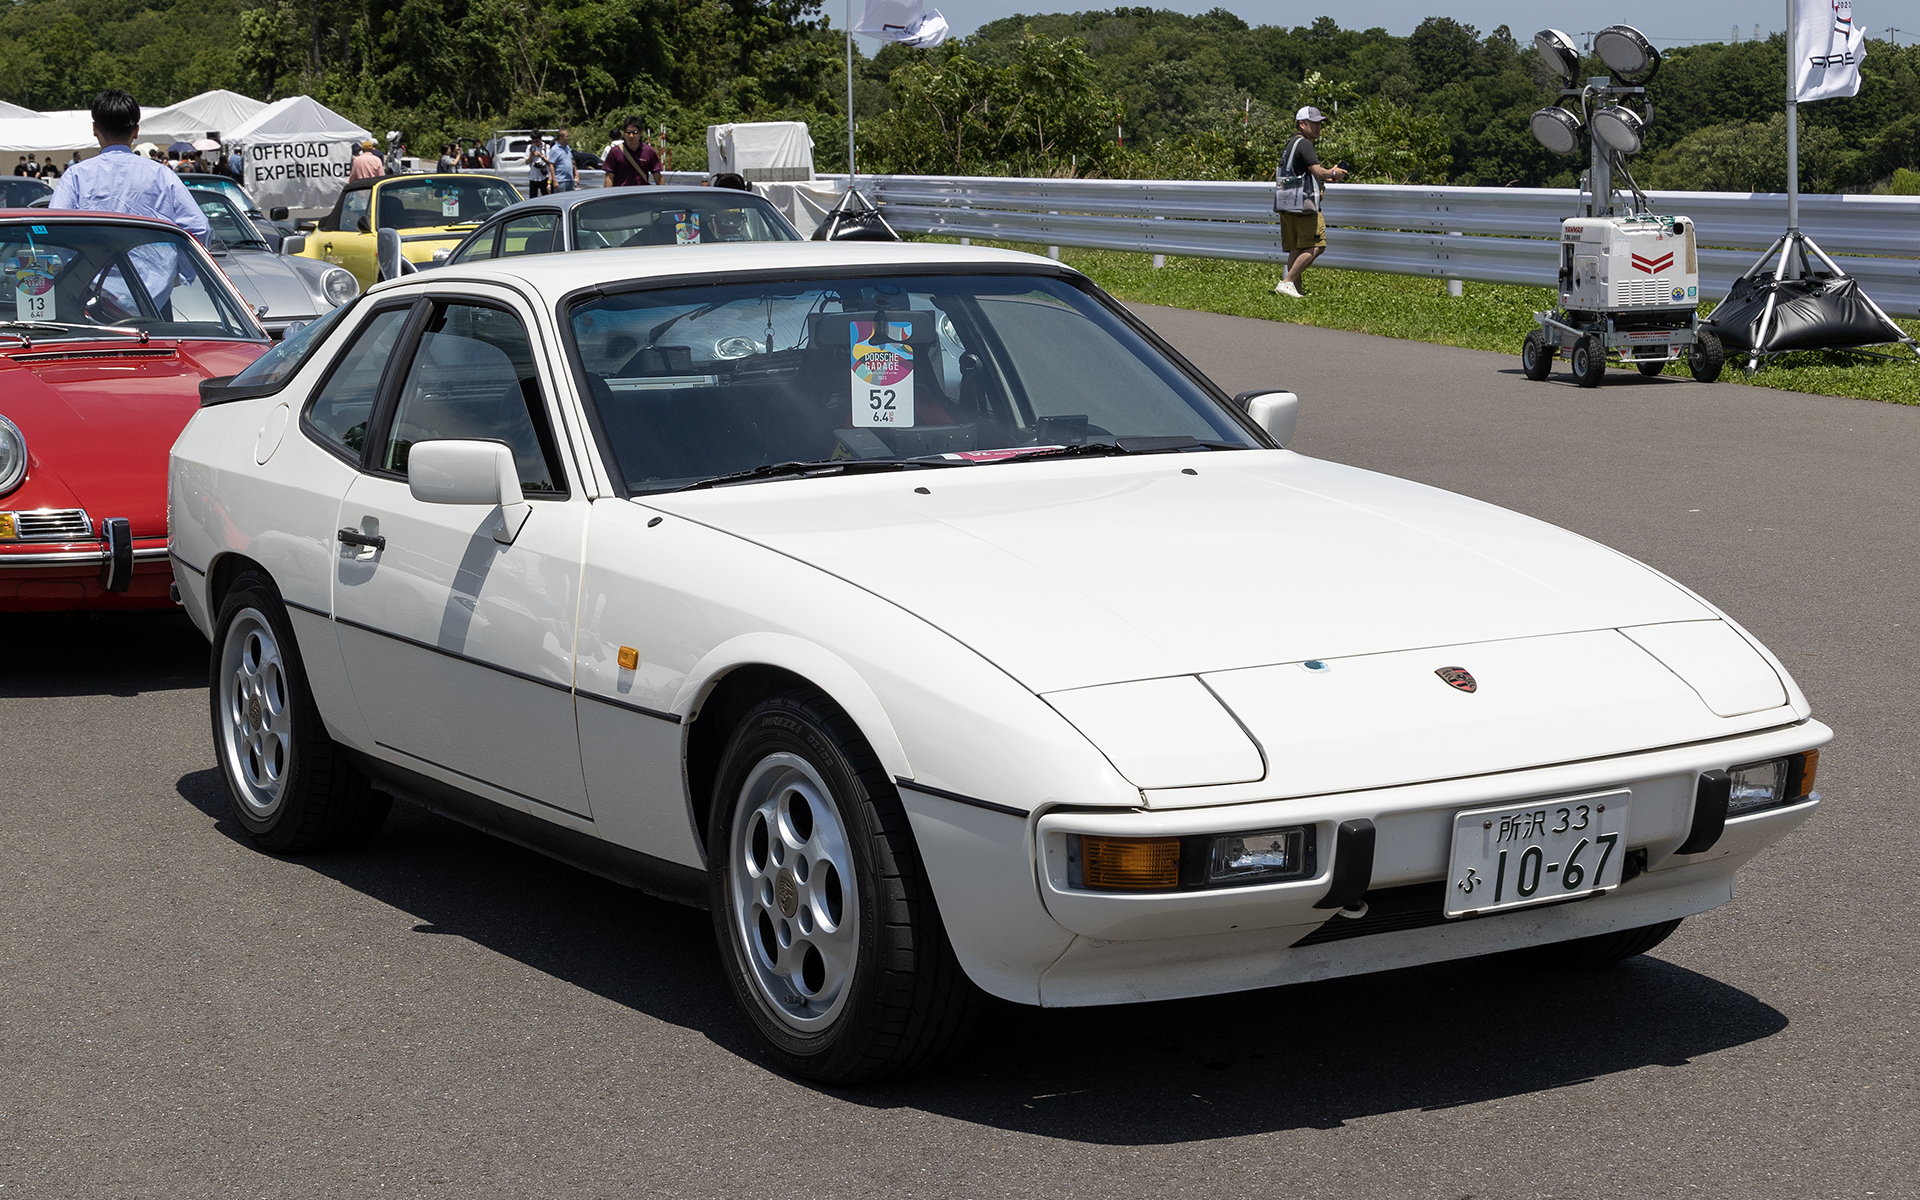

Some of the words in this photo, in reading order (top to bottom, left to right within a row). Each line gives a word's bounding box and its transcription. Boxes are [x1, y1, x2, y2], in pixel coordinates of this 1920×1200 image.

[253, 143, 328, 161] OFFROAD
[255, 163, 352, 181] EXPERIENCE
[28, 297, 45, 310] 13
[864, 353, 899, 361] PORSCHE
[865, 362, 899, 370] GARAGE
[869, 389, 896, 410] 52
[873, 412, 889, 422] 6.4
[761, 716, 803, 735] DIREZZA
[806, 733, 834, 766] DZ102
[1496, 810, 1546, 842] 所沢
[1552, 805, 1590, 833] 33
[1457, 867, 1482, 893] ふ
[1494, 831, 1619, 903] 10-67
